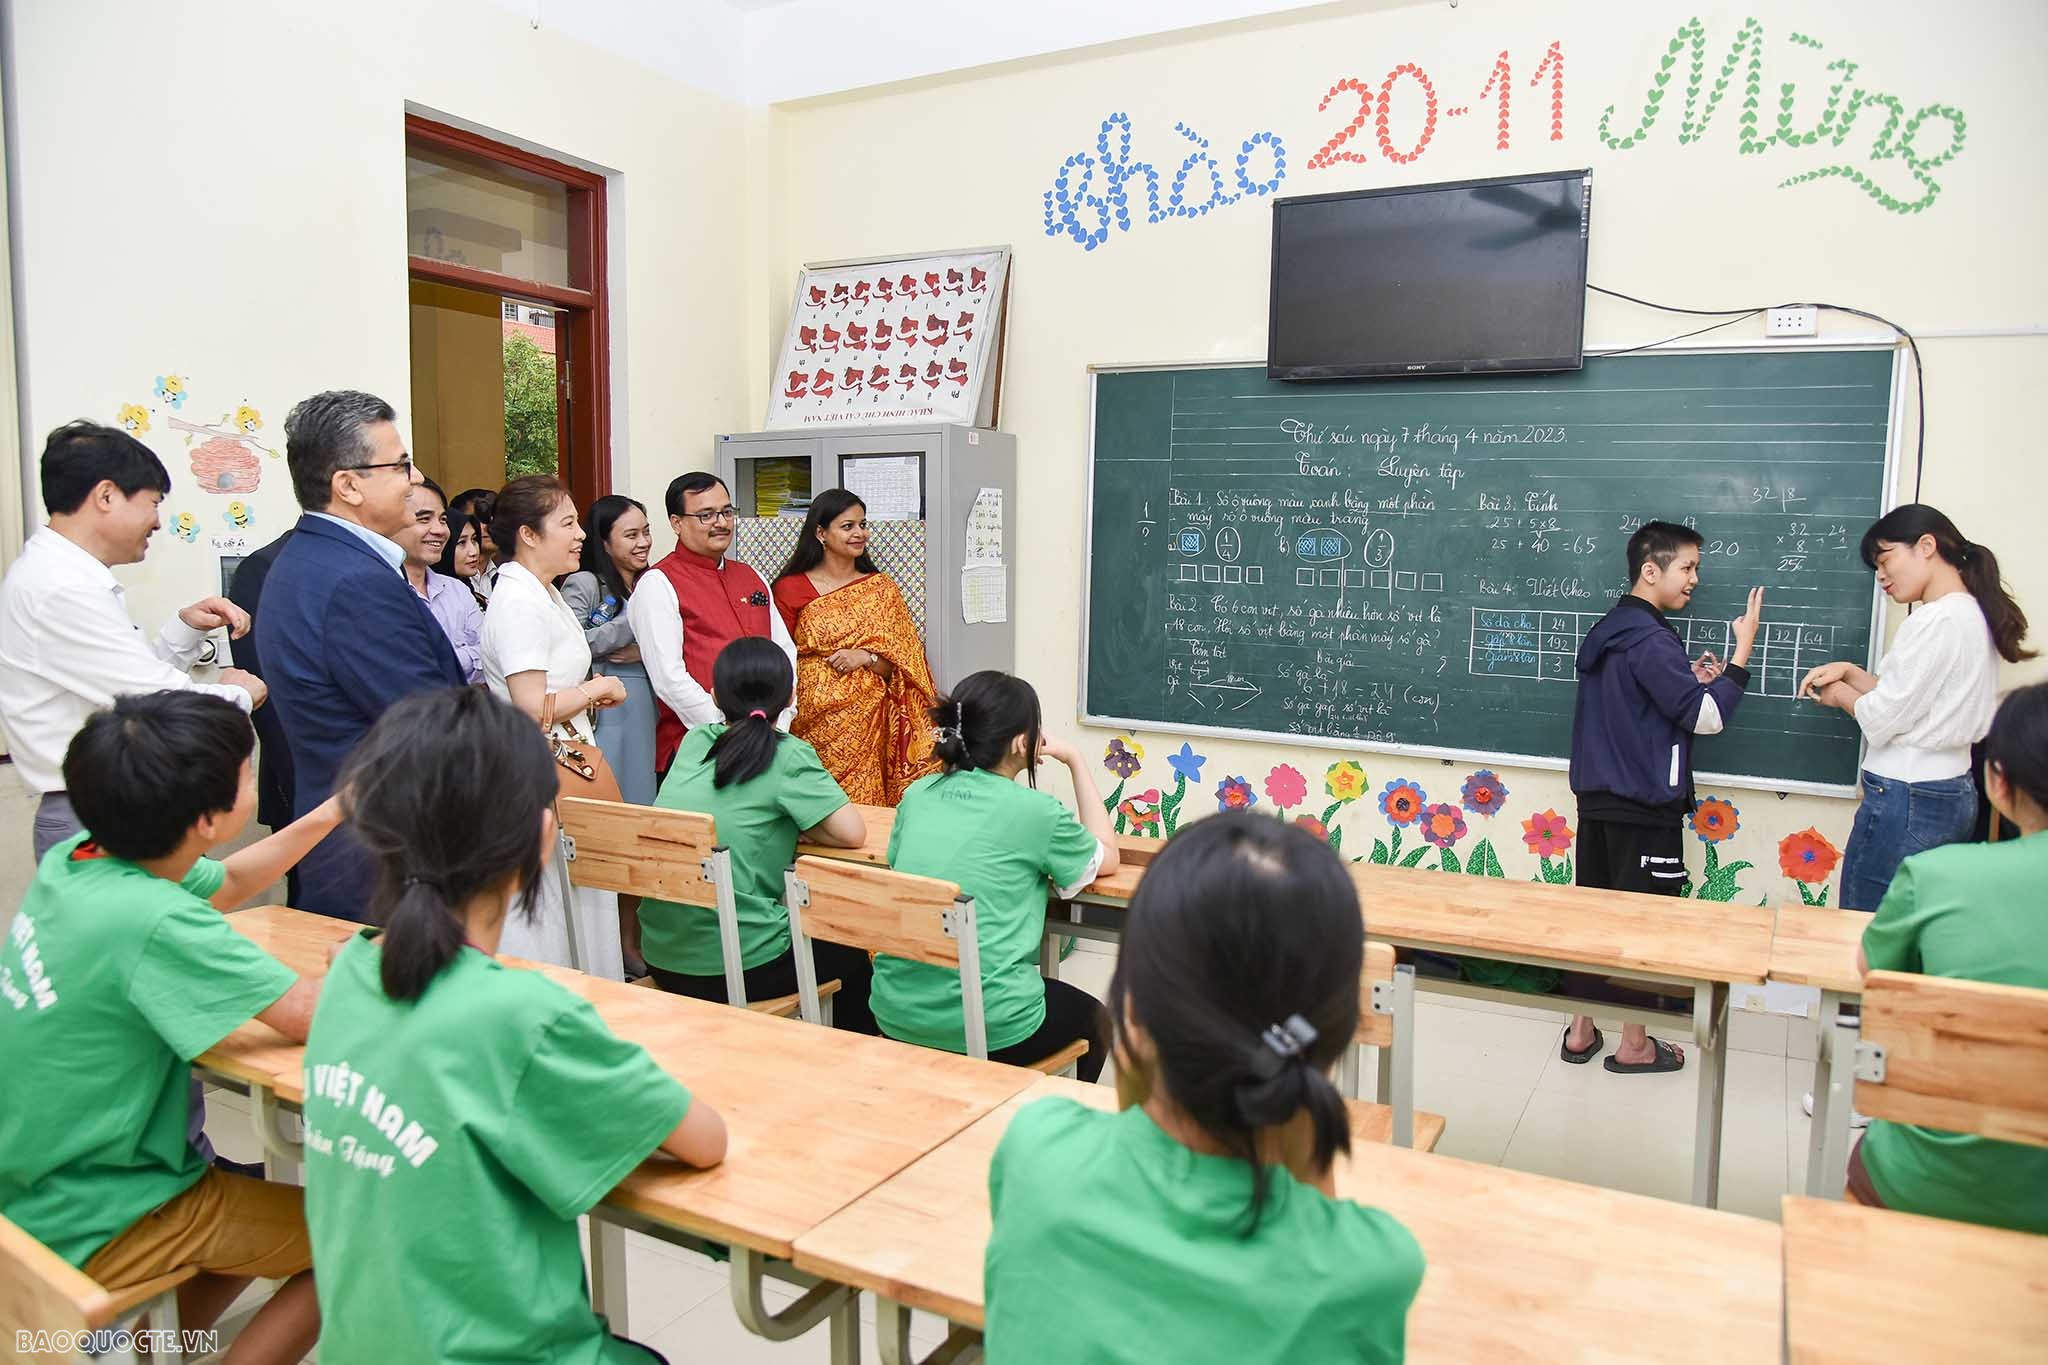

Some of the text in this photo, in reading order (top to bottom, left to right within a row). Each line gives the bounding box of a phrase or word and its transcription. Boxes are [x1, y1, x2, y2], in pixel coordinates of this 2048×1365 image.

[1308, 40, 1563, 170] 20-11
[1329, 424, 1355, 445] sáu
[1361, 427, 1398, 452] ngày
[1401, 426, 1410, 444] 7
[1412, 424, 1460, 455] tháng
[1464, 428, 1478, 444] 4
[1483, 428, 1518, 445] năm
[1377, 456, 1431, 488] Luyện
[1438, 462, 1465, 491] tập
[1278, 494, 1305, 508] màu
[1251, 511, 1284, 536] vuông
[1291, 512, 1321, 524] màu
[1551, 616, 1566, 632] 24
[1546, 634, 1570, 651] 192
[1552, 655, 1562, 673] 3
[314, 1060, 365, 1108] VIỆT
[361, 1083, 439, 1169] NAM
